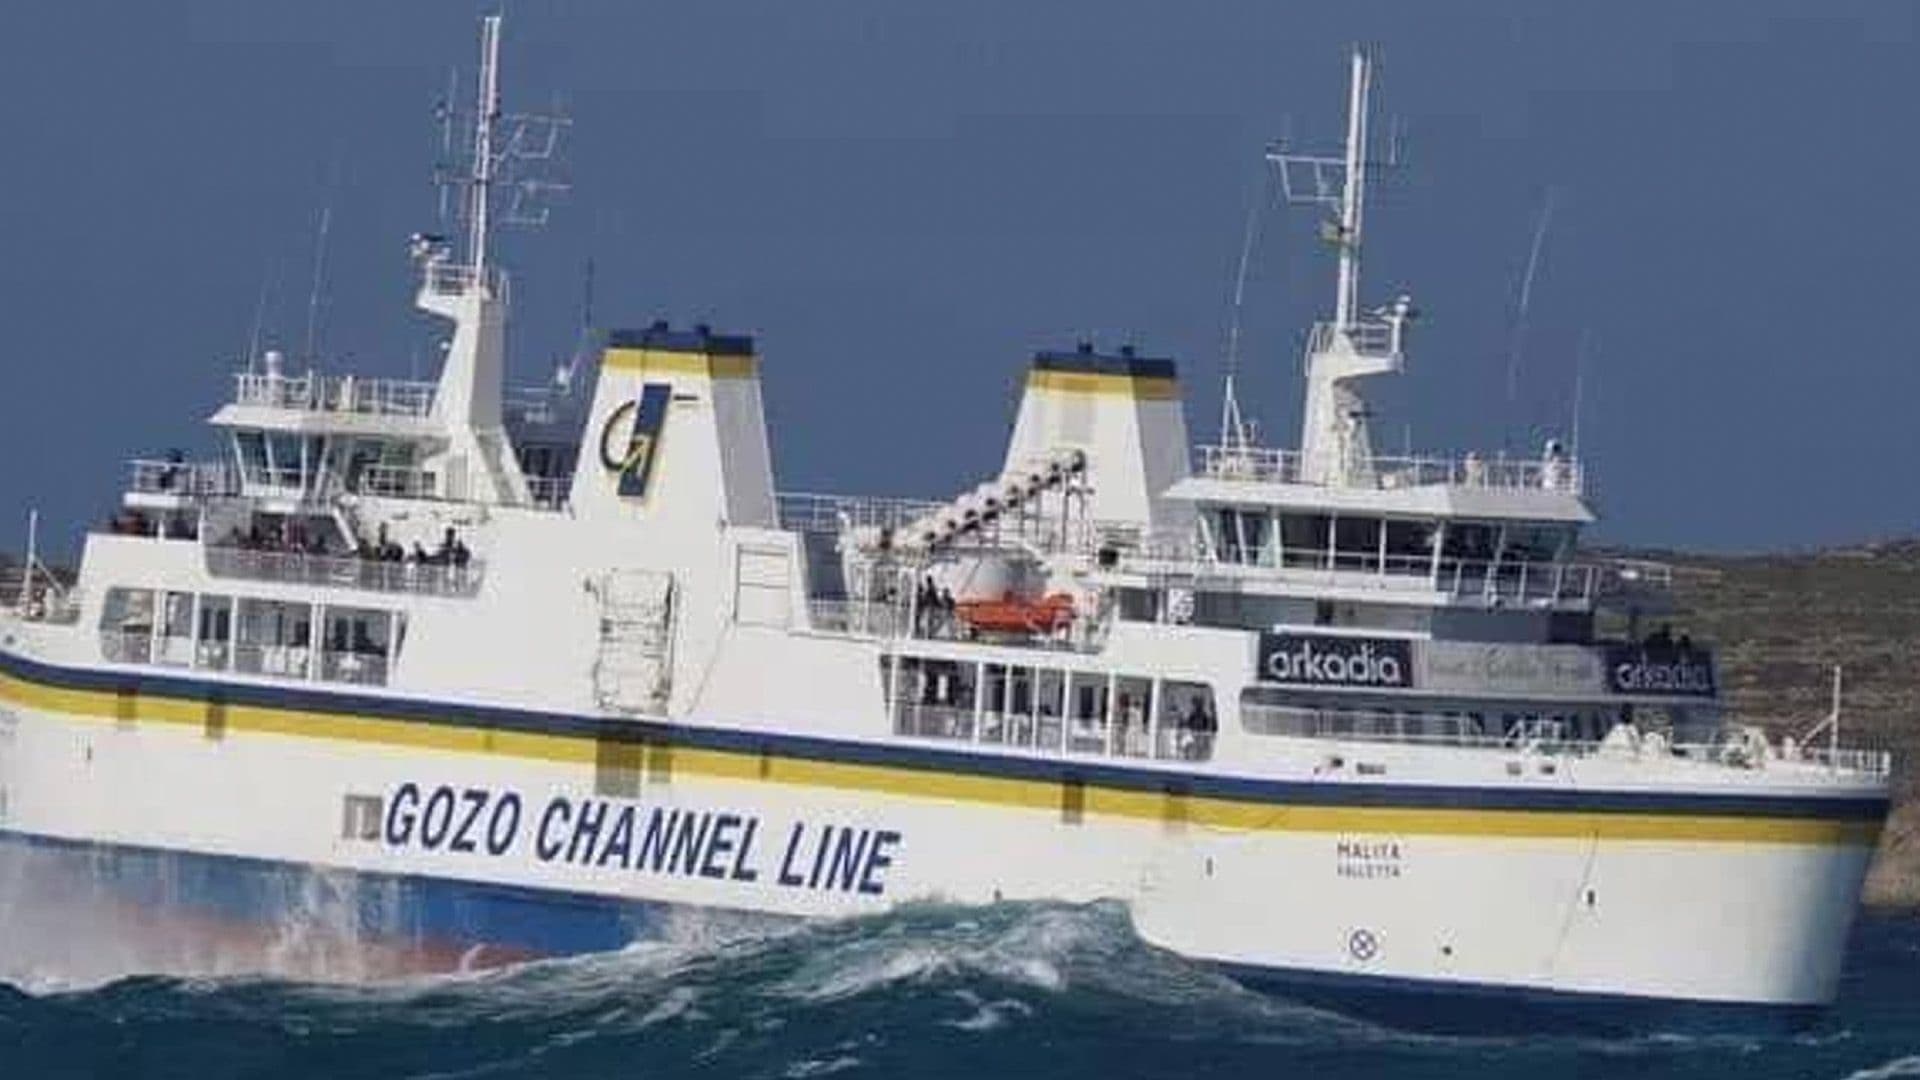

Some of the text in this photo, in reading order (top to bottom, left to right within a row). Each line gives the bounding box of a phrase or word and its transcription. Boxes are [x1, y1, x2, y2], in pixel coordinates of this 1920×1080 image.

[1269, 640, 1401, 683] arkadia
[385, 781, 902, 895] GOZO CHANNEL LINE
